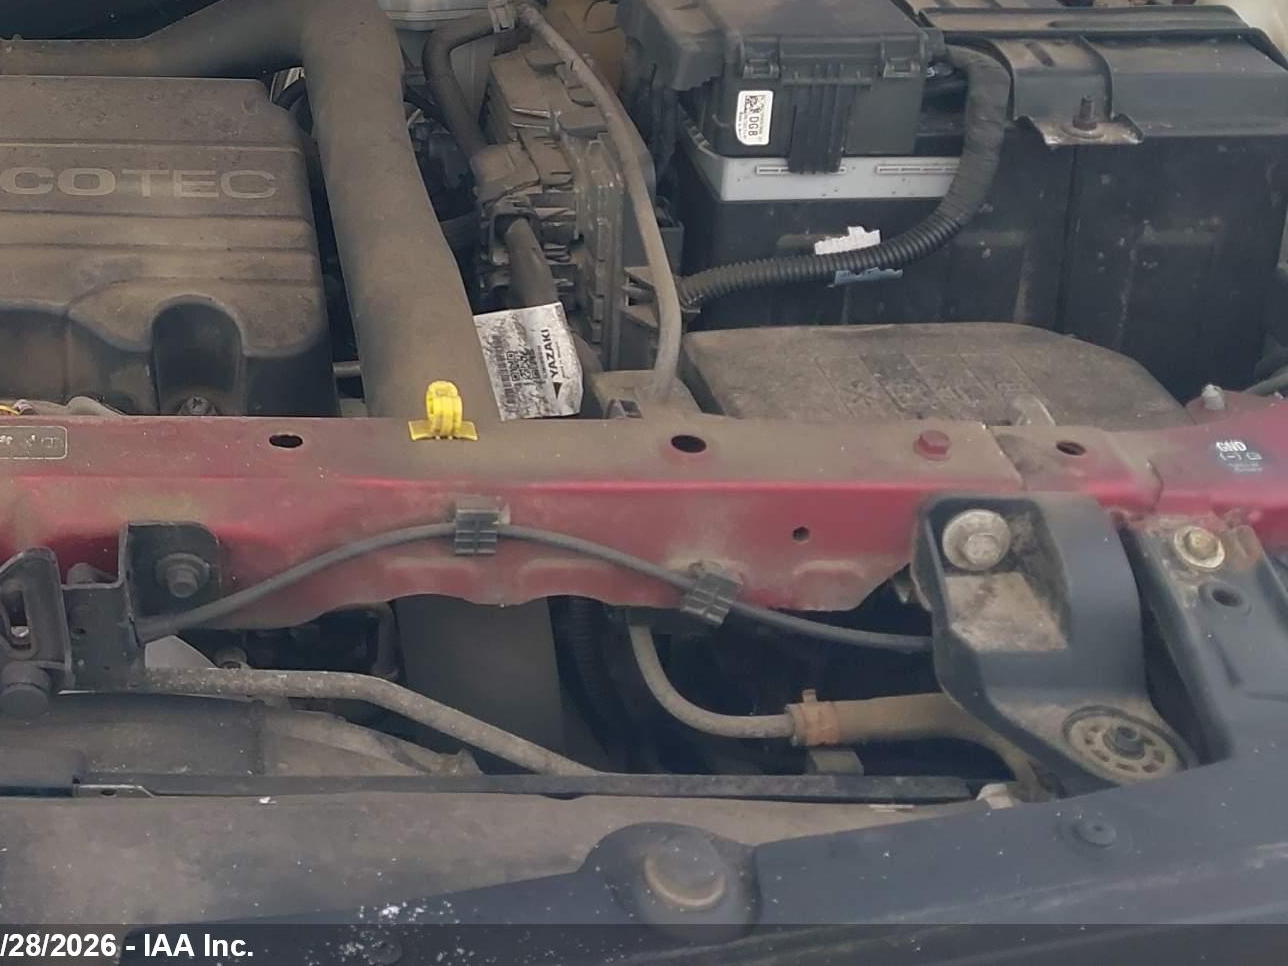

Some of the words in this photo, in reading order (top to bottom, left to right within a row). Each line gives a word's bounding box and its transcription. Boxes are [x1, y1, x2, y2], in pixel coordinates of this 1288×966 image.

[748, 116, 760, 136] DGB
[540, 329, 560, 379] YAZAKI
[1215, 440, 1247, 452] GND
